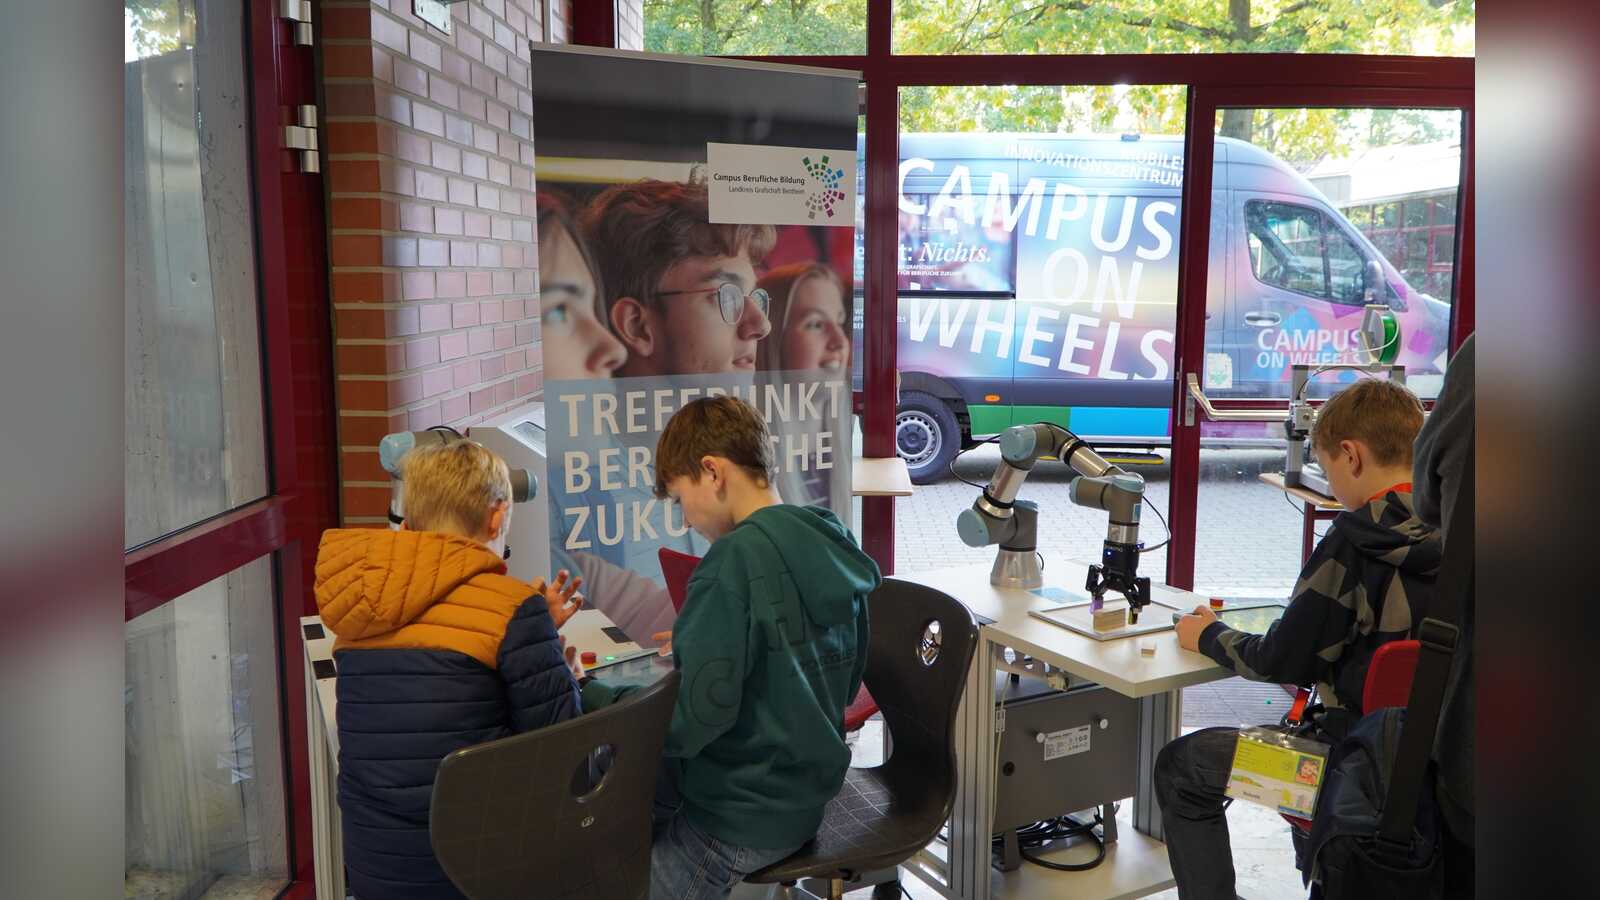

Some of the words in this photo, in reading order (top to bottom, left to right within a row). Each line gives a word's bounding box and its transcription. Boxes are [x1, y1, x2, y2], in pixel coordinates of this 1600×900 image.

[713, 172, 741, 182] Campus
[743, 174, 778, 184] Berufliche
[780, 175, 805, 186] Bildung
[728, 185, 753, 193] Landkreis
[755, 186, 781, 194] Grafschaft
[898, 157, 1178, 261] CAMPUS
[919, 241, 992, 263] Nichts.
[1041, 247, 1143, 320] ON
[908, 281, 1175, 381] WHEELS
[1256, 351, 1284, 369] ON
